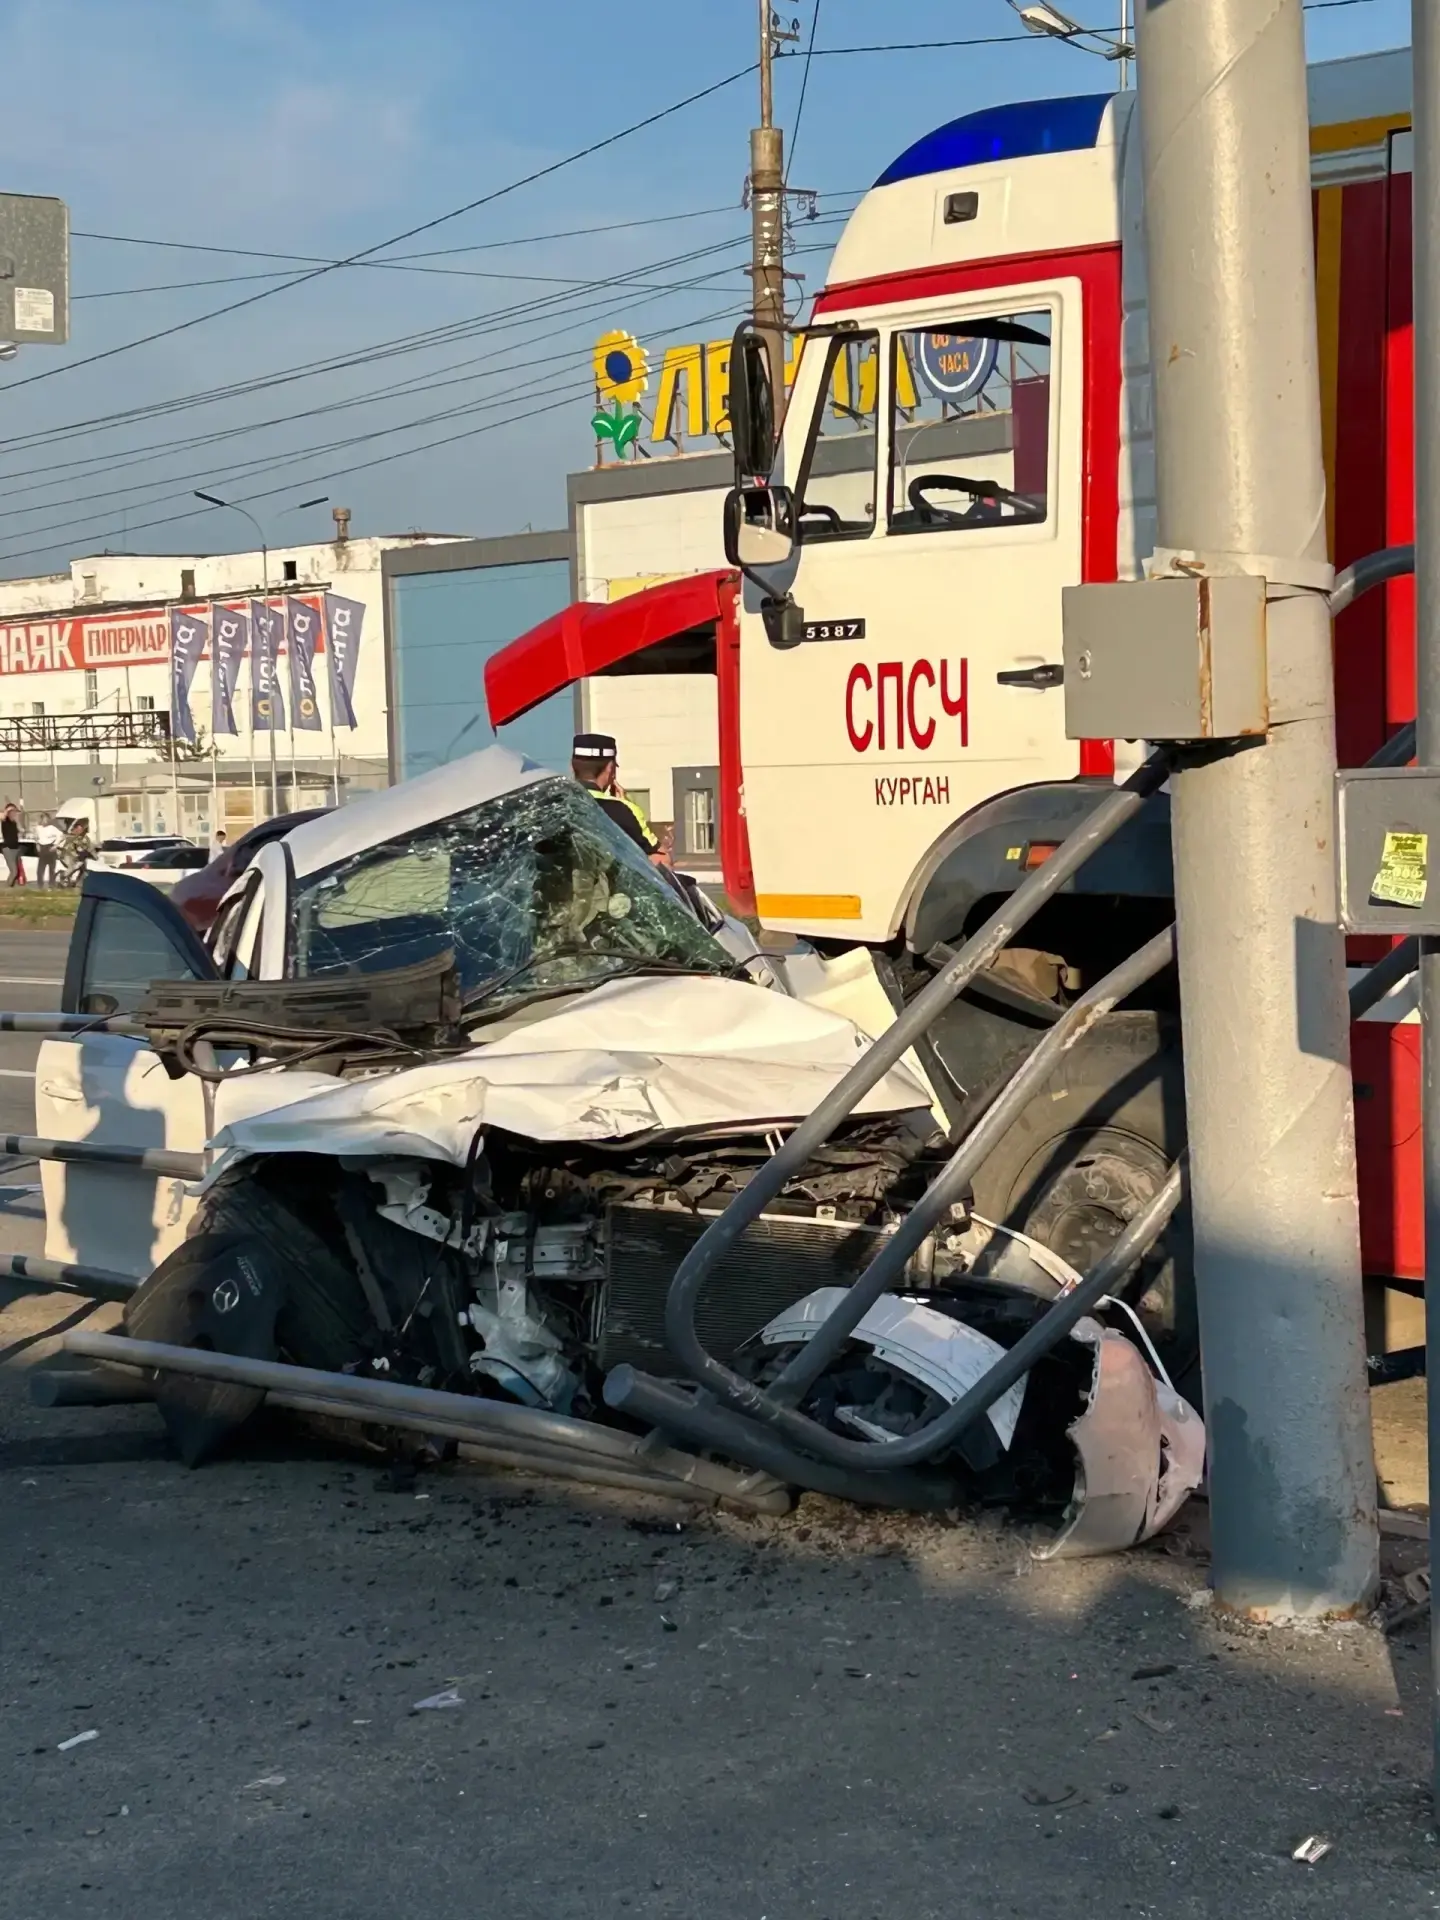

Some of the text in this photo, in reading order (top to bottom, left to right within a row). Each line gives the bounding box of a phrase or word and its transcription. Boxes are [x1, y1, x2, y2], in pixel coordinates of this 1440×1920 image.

[939, 352, 969, 375] ЧАСА
[88, 624, 167, 656] ГИПЕРМАР
[332, 608, 352, 682] ЕНТА
[806, 624, 858, 639] 5387
[845, 657, 969, 753] СПСЧ
[875, 775, 951, 806] КУРГАН
